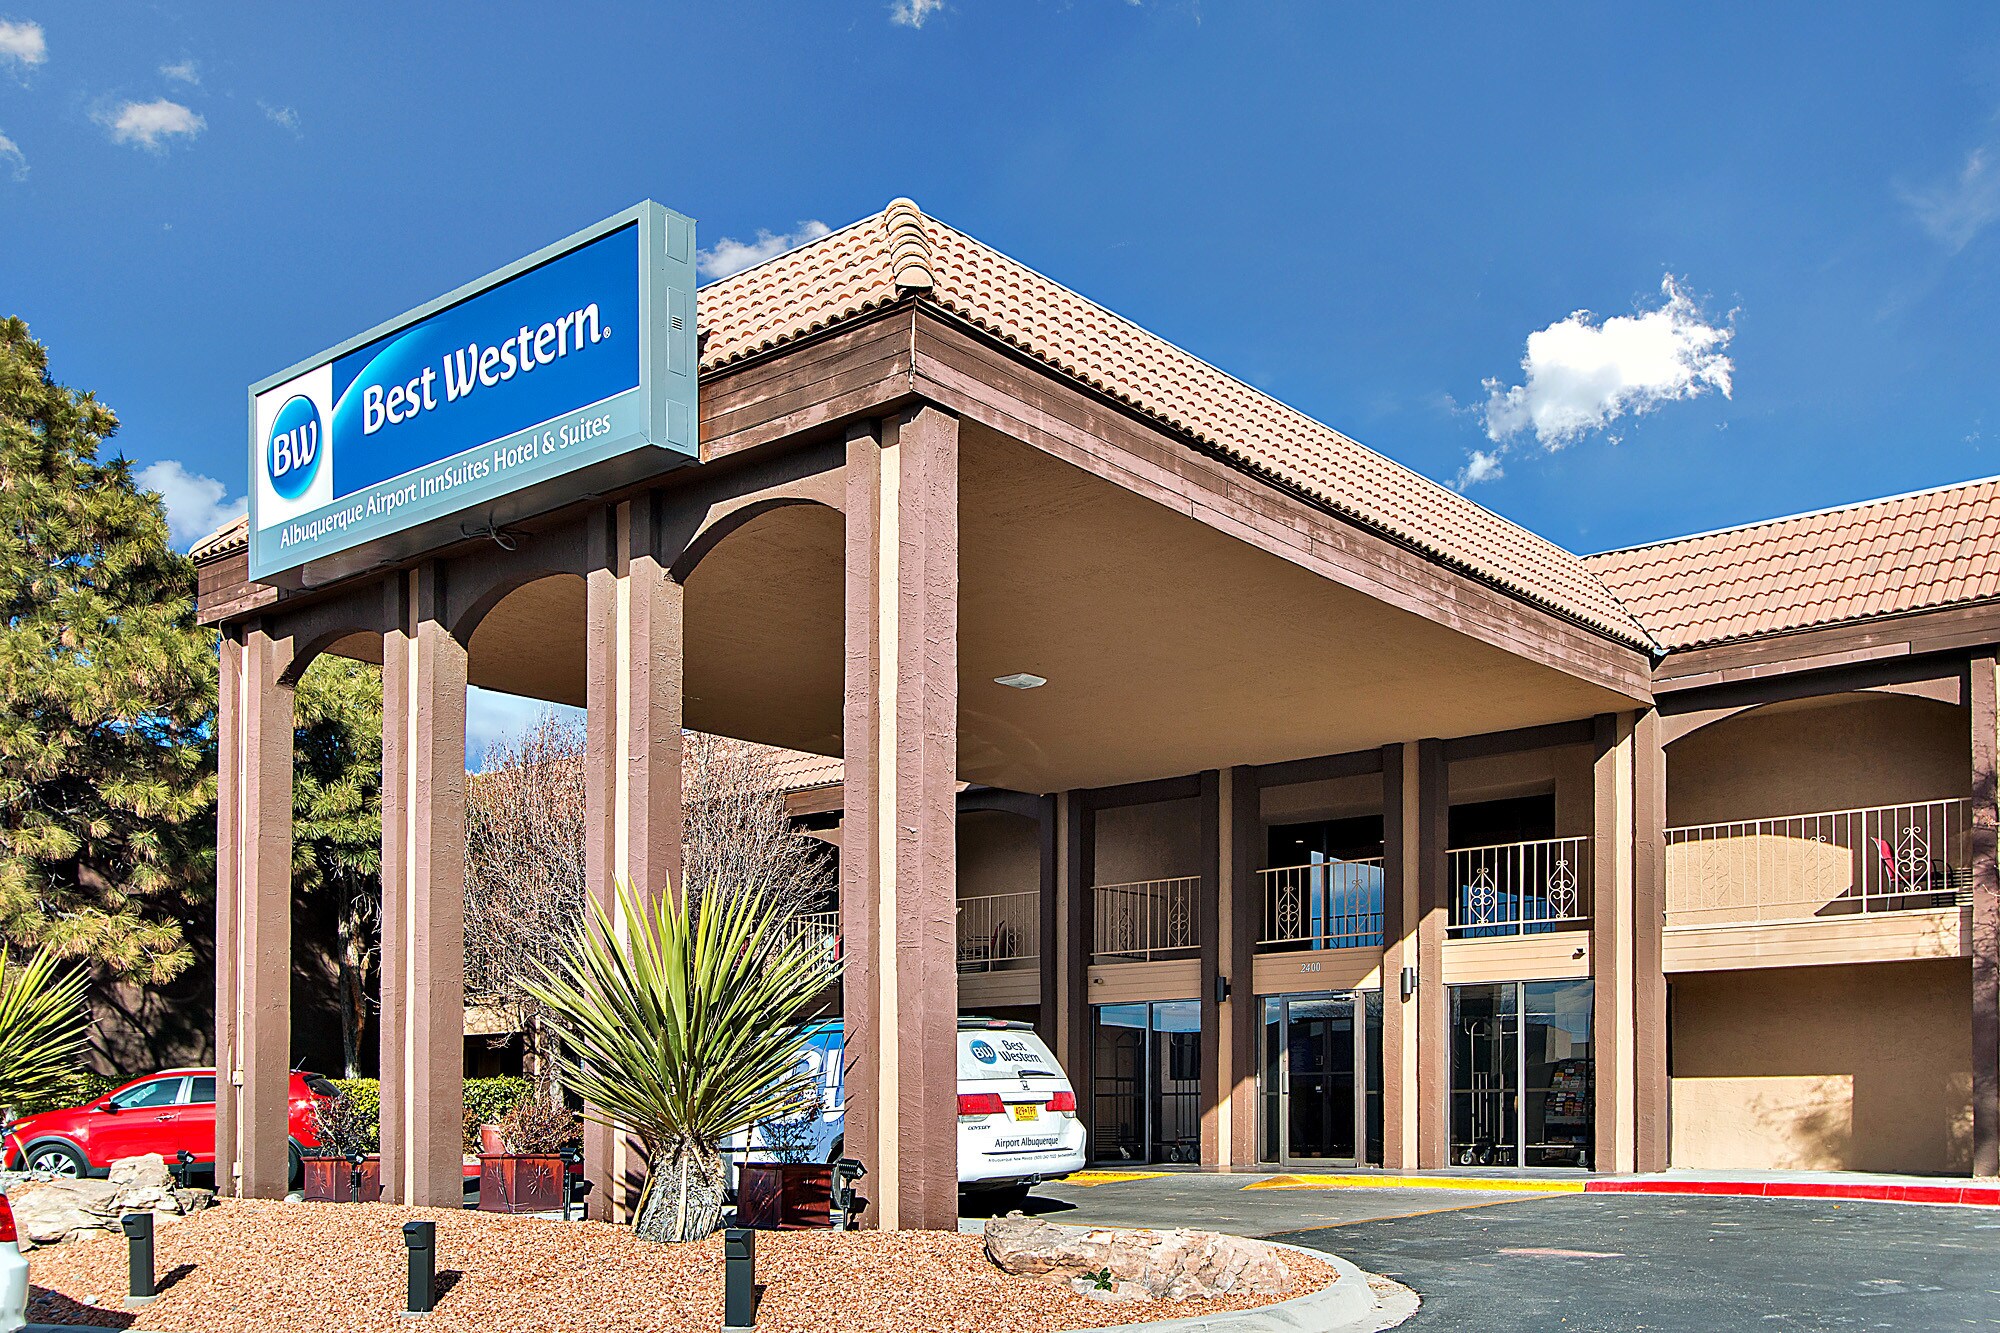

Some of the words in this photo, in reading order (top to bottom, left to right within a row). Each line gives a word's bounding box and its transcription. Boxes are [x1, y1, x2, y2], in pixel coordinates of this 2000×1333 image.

[363, 366, 438, 435] Best
[273, 420, 318, 477] BW
[280, 504, 364, 549] Albuquerque
[366, 483, 417, 517] Airport
[420, 457, 490, 499] InnSuites
[494, 435, 539, 473] Hotel
[541, 431, 556, 455] &
[559, 414, 611, 449] Suites
[1300, 962, 1321, 973] 2400
[1001, 1039, 1027, 1052] Best
[972, 1046, 994, 1059] BW
[998, 1050, 1042, 1063] Western
[994, 1138, 1020, 1149] Airport
[1020, 1137, 1059, 1147] Albuquerque
